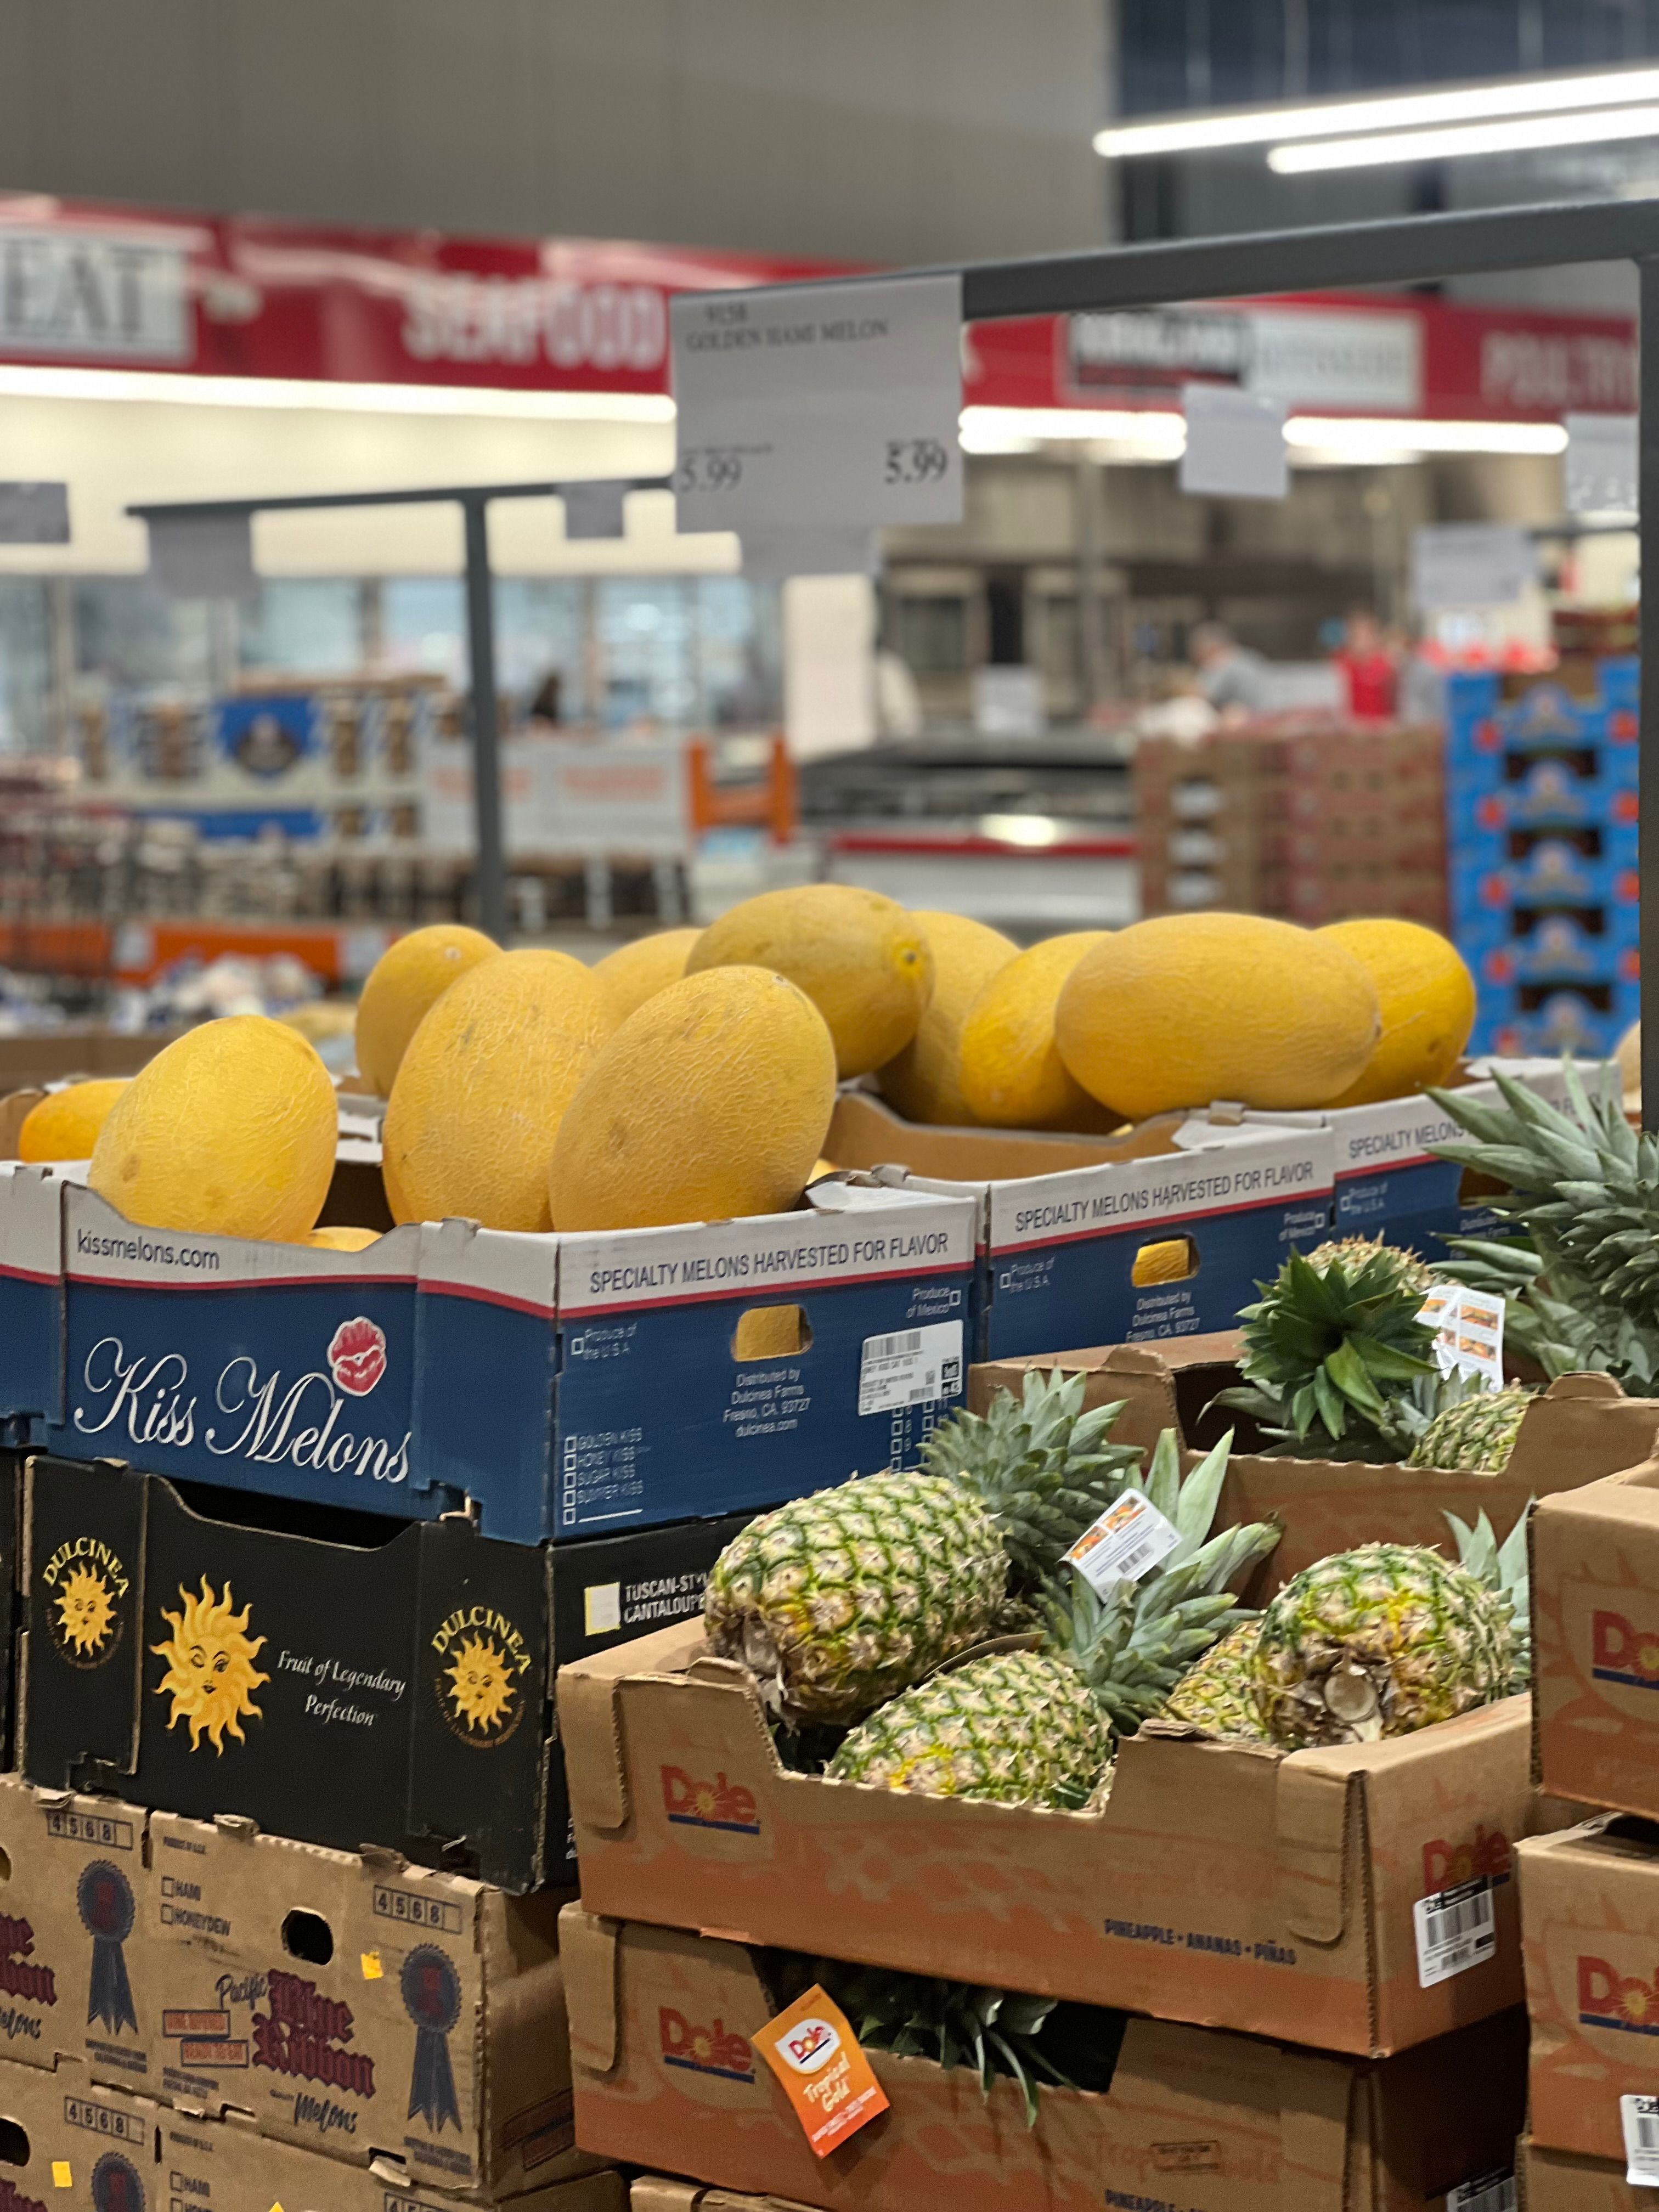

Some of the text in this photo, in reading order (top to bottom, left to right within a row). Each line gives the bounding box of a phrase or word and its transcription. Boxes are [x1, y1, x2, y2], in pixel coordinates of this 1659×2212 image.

[0, 238, 155, 341] EAT
[686, 330, 761, 352] GOLDEN
[820, 319, 889, 342] MELON
[679, 454, 743, 493] 5.99
[884, 442, 948, 485] 5.99
[1348, 1126, 1414, 1159] SPECIALTY
[1015, 1161, 1314, 1232] SPECIALTY MELONS HARVESTED FOR FLAVOR
[77, 1228, 220, 1271] kissmelons.com
[590, 1232, 949, 1294] SPECIALTY MELONS HARVESTED FOR FLAVOR
[906, 1303, 950, 1318] of Mexico
[912, 1287, 950, 1301] Produce
[1169, 1306, 1195, 1319] Farms
[731, 1384, 805, 1406] Dulcinea Farms
[736, 1368, 802, 1388] Distributed by
[74, 1336, 413, 1483] Kiss Melons
[43, 1537, 130, 1599] DULCINEA
[625, 1572, 708, 1602] TUSCAN-STYL
[431, 1606, 532, 1675] DULCINEA
[1593, 1610, 1659, 1681] Do
[276, 1650, 407, 1701] Fruit of Legendary
[304, 1694, 375, 1727] Perfection
[661, 1764, 757, 1824] Dole
[659, 2006, 753, 2072] Dole
[788, 2025, 826, 2061] Dole
